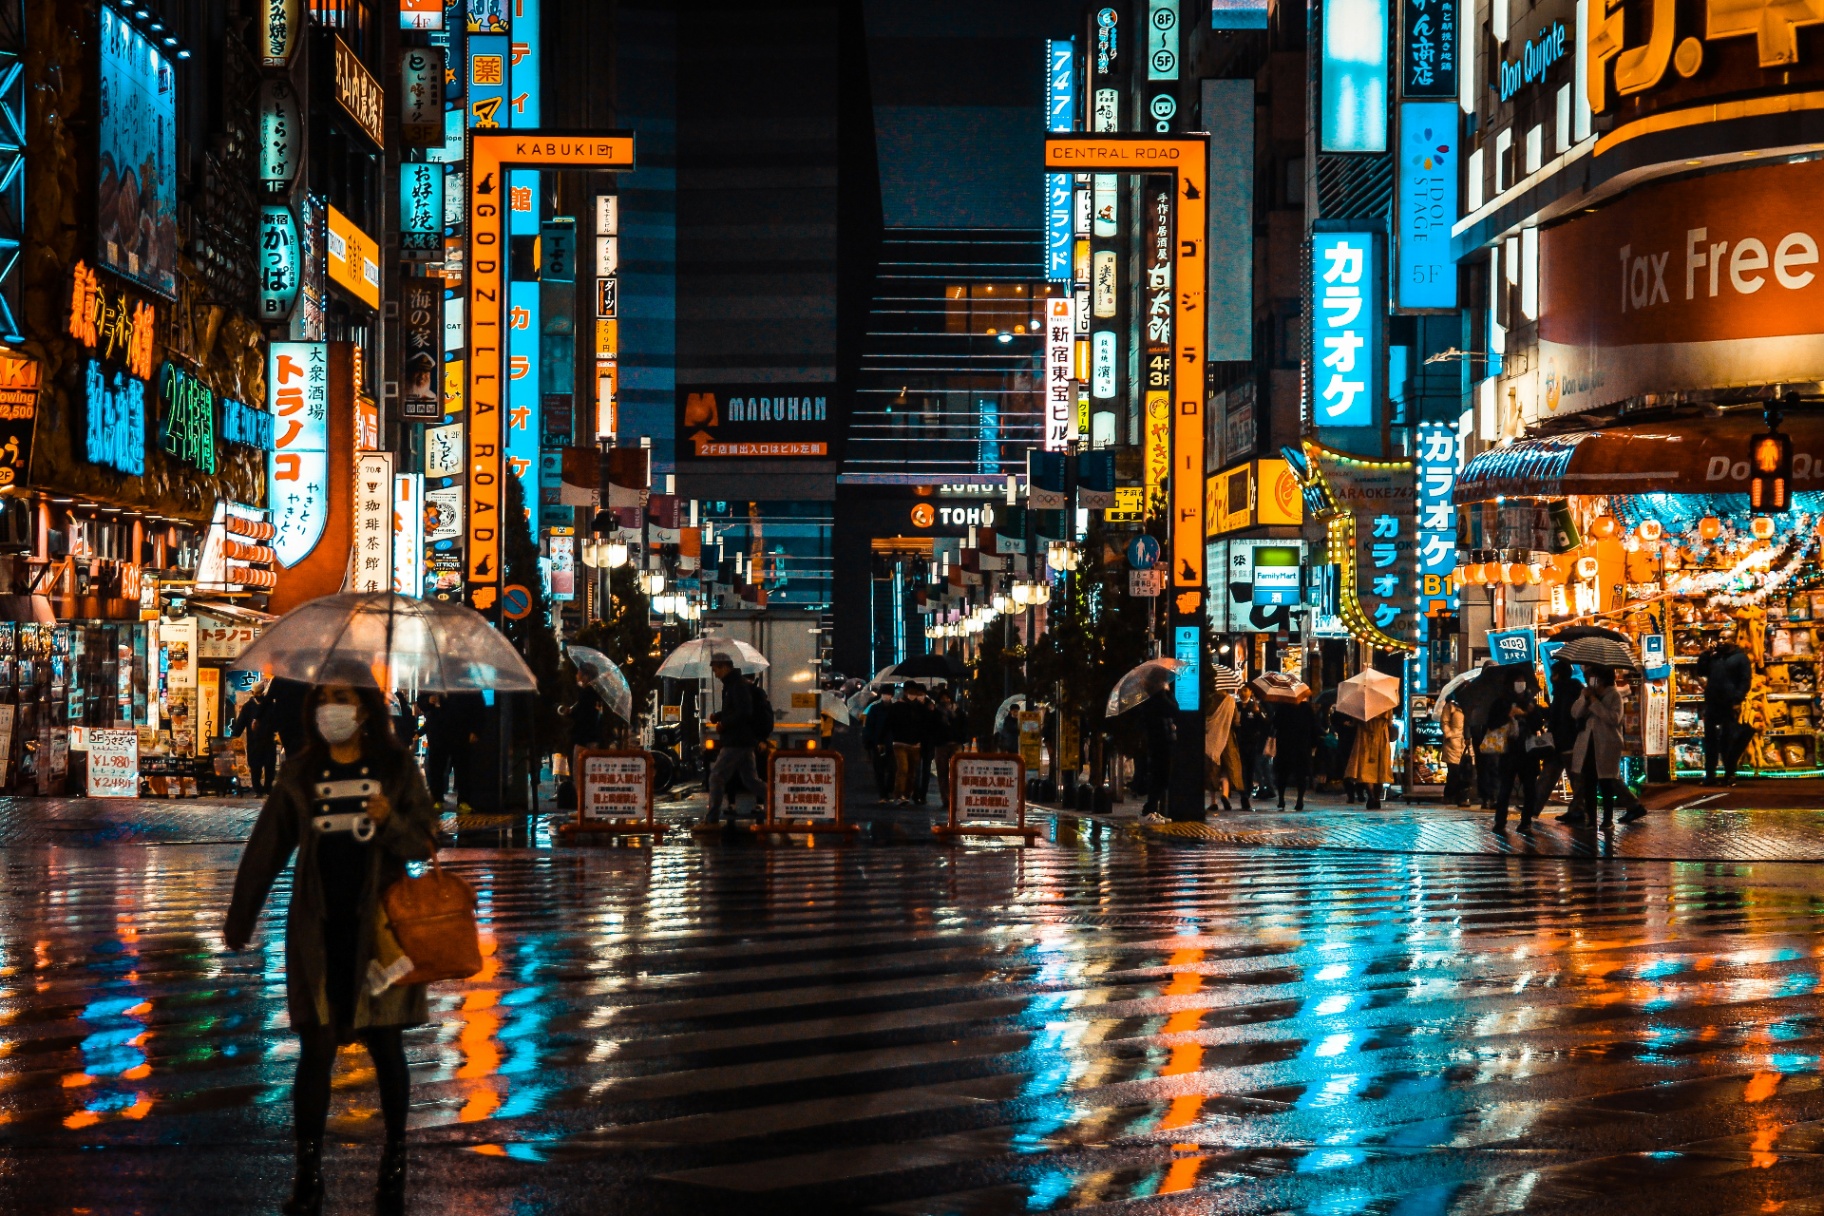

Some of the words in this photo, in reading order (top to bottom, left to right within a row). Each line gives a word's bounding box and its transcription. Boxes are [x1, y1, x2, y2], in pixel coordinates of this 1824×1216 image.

[411, 13, 431, 28] 4F
[1157, 14, 1171, 24] 8F
[475, 58, 500, 82] 薬
[1157, 56, 1171, 67] 5F
[1501, 58, 1521, 102] Don
[1524, 20, 1565, 83] Quijote
[1052, 51, 1071, 115] 747
[273, 102, 288, 176] とらそば
[1052, 147, 1128, 159] CENTRAL
[1135, 147, 1180, 159] ROAD
[266, 181, 285, 192] 1F
[409, 164, 434, 231] お好み焼
[263, 214, 289, 225] 新宿
[1413, 177, 1428, 242] STAGE
[1430, 178, 1444, 231] IDOL
[402, 234, 440, 249] 大阪家
[1156, 192, 1169, 260] 手作り居酒屋
[262, 226, 290, 291] かっぱ
[549, 236, 564, 273] TFC
[1620, 243, 1669, 313] Tax
[1686, 227, 1819, 300] Free
[1413, 265, 1442, 284] 5F
[265, 300, 286, 312] B1
[410, 288, 432, 348] 海の家
[475, 204, 496, 416] GODZILLA
[1322, 241, 1364, 417] カラオケ
[0, 359, 38, 387] KI
[1149, 355, 1169, 370] 4F
[1149, 371, 1169, 386] 3F
[308, 347, 325, 420] 大衆酒場
[510, 306, 532, 478] カラオケ
[1180, 238, 1201, 522] ゴジラロード
[274, 355, 304, 481] トラノコ
[728, 396, 827, 422] MARUHAN
[542, 434, 571, 447] Cafe
[701, 443, 820, 455] 2F店舗出入口はビル左側
[1706, 455, 1751, 481] Do
[474, 443, 495, 542] ROAD
[1422, 430, 1455, 567] カラオケ
[275, 492, 301, 547] やきとん
[299, 482, 319, 536] やきとり
[939, 507, 995, 525] TOHO
[1257, 571, 1297, 581] FamilyMart
[1372, 514, 1401, 628] カラオケ
[1424, 574, 1454, 595] B1
[1271, 592, 1283, 604] 酒
[202, 629, 252, 642] トラノコ
